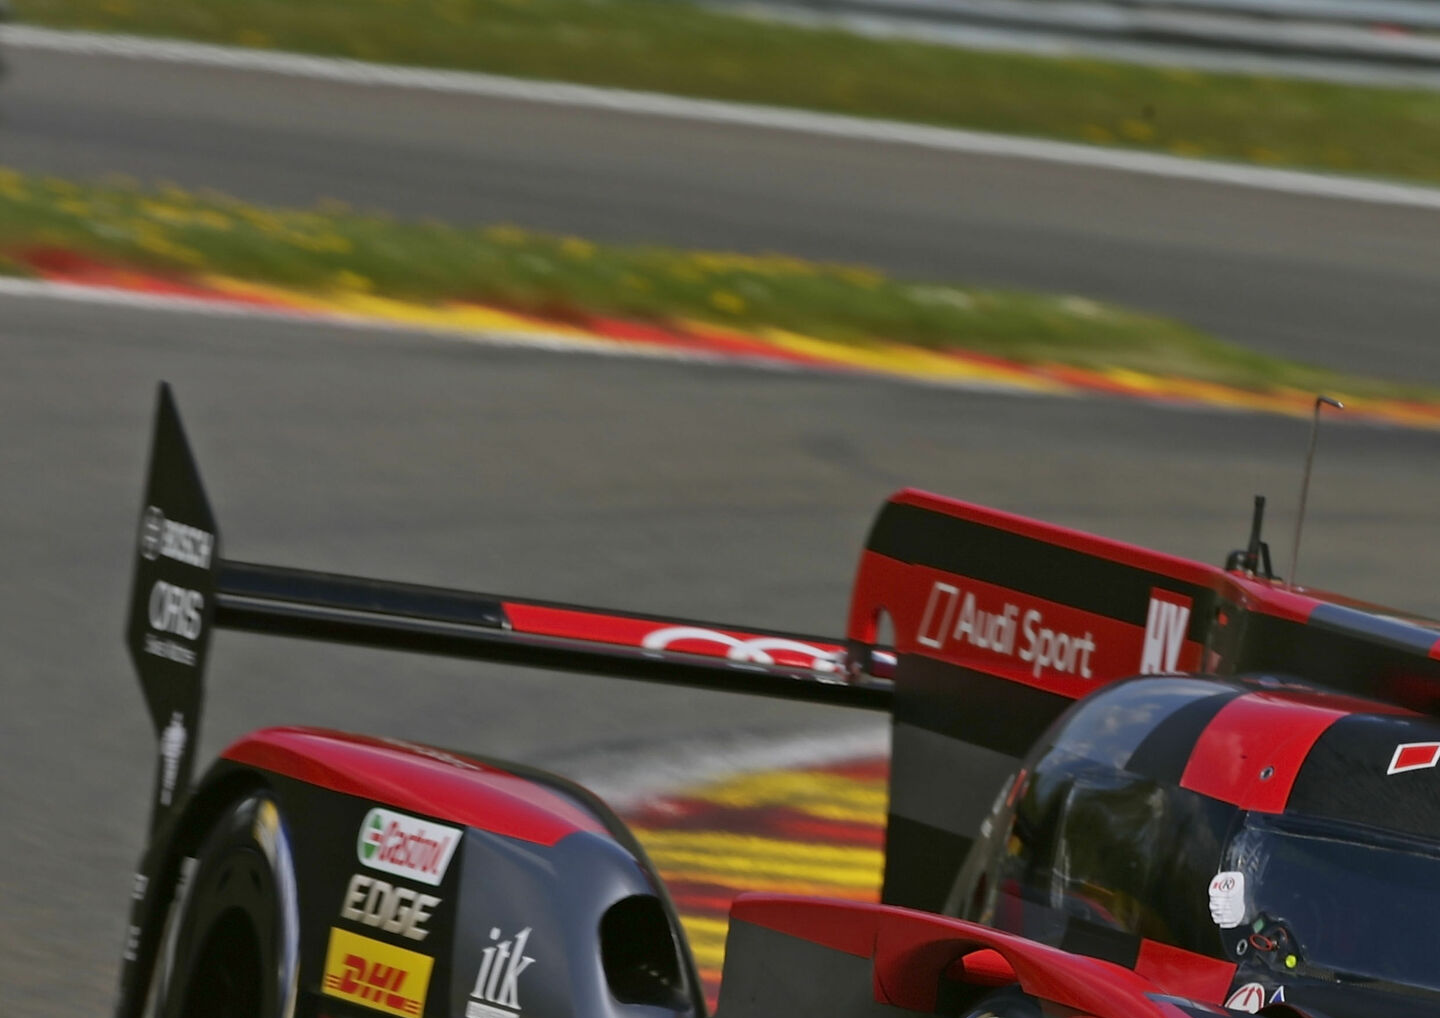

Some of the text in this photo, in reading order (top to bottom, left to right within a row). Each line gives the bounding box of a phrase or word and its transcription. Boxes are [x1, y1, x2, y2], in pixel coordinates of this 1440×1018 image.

[953, 591, 1096, 680] Audi Sport
[1140, 597, 1191, 676] HY
[379, 820, 450, 876] Castrol
[341, 873, 443, 942] EDGE
[339, 953, 408, 1010] DHL
[469, 926, 537, 1010] itk
